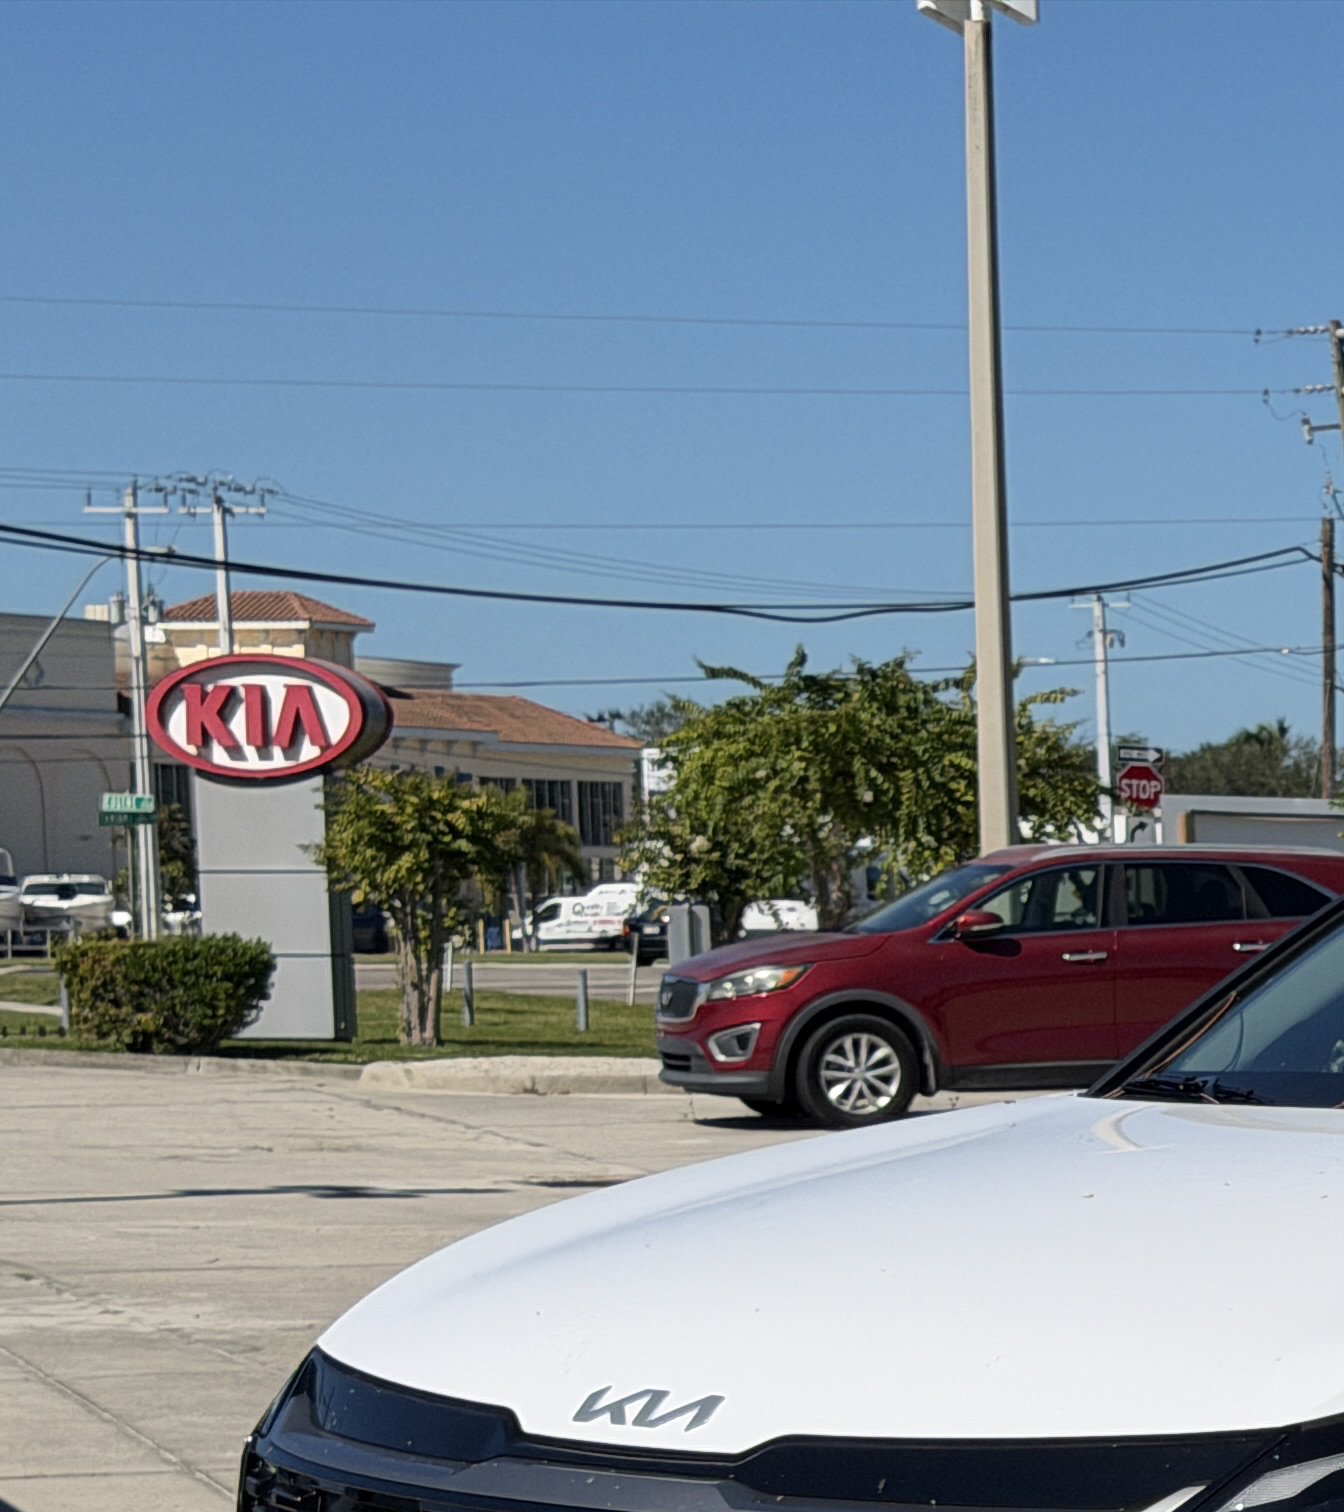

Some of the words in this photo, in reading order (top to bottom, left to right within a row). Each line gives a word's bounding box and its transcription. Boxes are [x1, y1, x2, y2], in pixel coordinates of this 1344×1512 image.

[182, 683, 328, 748] KIA
[1121, 779, 1161, 799] STOP
[572, 1385, 725, 1432] KIA
